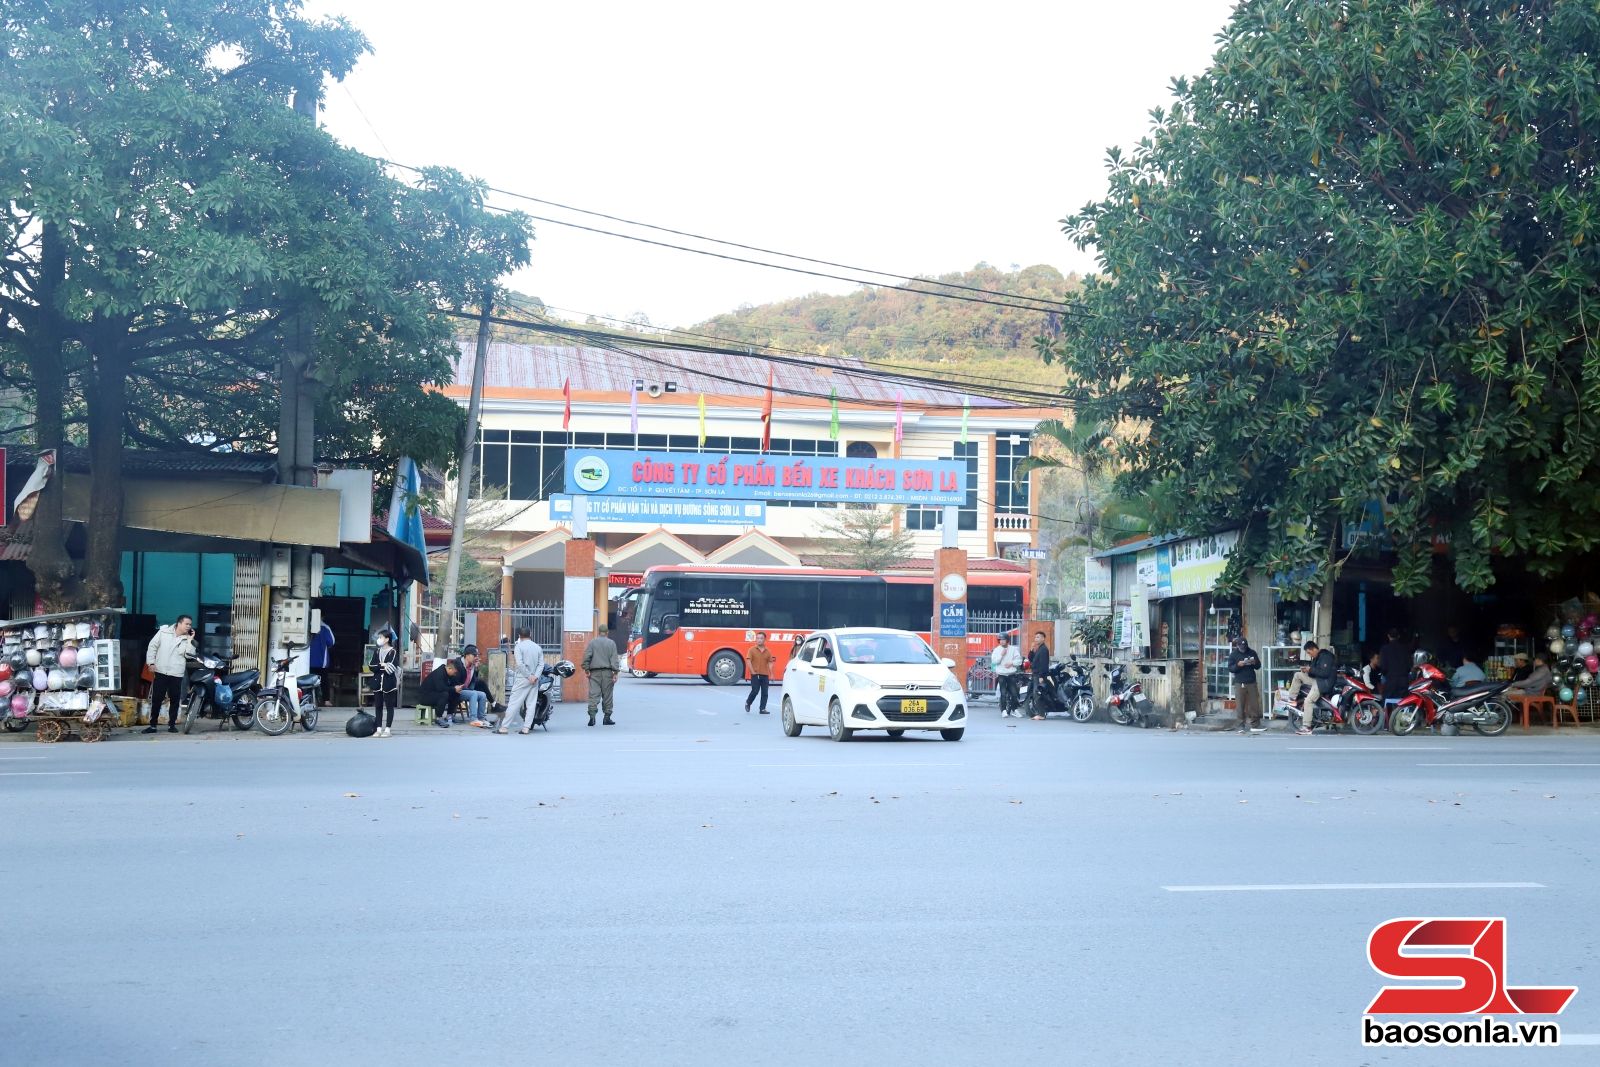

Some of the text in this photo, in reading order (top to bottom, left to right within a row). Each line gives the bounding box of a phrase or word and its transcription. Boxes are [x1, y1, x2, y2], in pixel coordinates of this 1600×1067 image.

[632, 457, 674, 485] CÔNG
[682, 463, 700, 485] TY
[706, 456, 729, 486] CỔ
[782, 460, 812, 488] BẾN
[819, 466, 839, 489] XE
[845, 464, 895, 490] KHÁCH
[902, 469, 933, 492] SƠN
[940, 471, 958, 493] LA
[942, 604, 964, 617] CẤM
